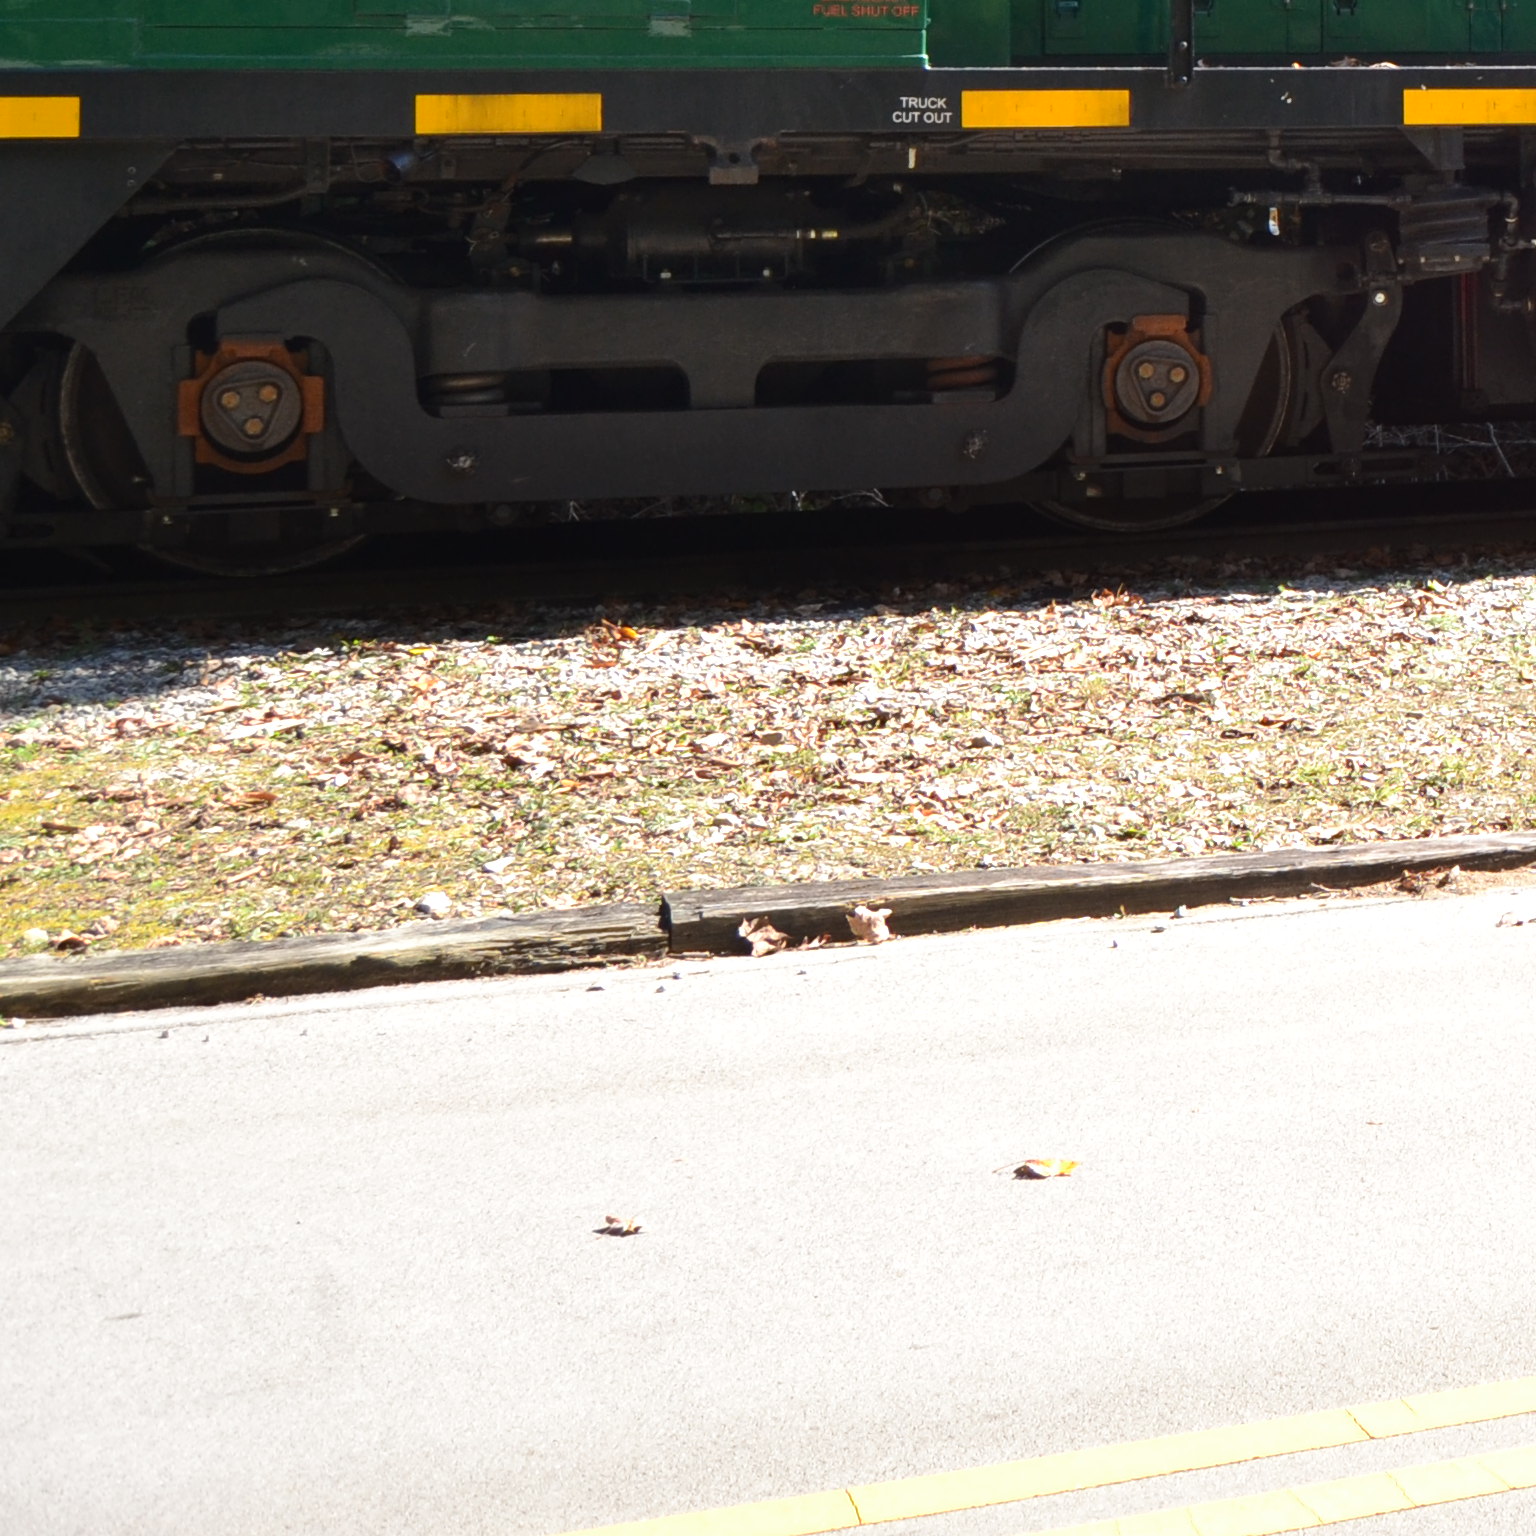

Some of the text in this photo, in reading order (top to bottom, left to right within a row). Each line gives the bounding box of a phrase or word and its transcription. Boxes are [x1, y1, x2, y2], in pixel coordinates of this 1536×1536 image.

[813, 4, 919, 17] FUEL SHUT OFF
[899, 96, 947, 109] TRUCK
[892, 111, 953, 124] CUT OUT
